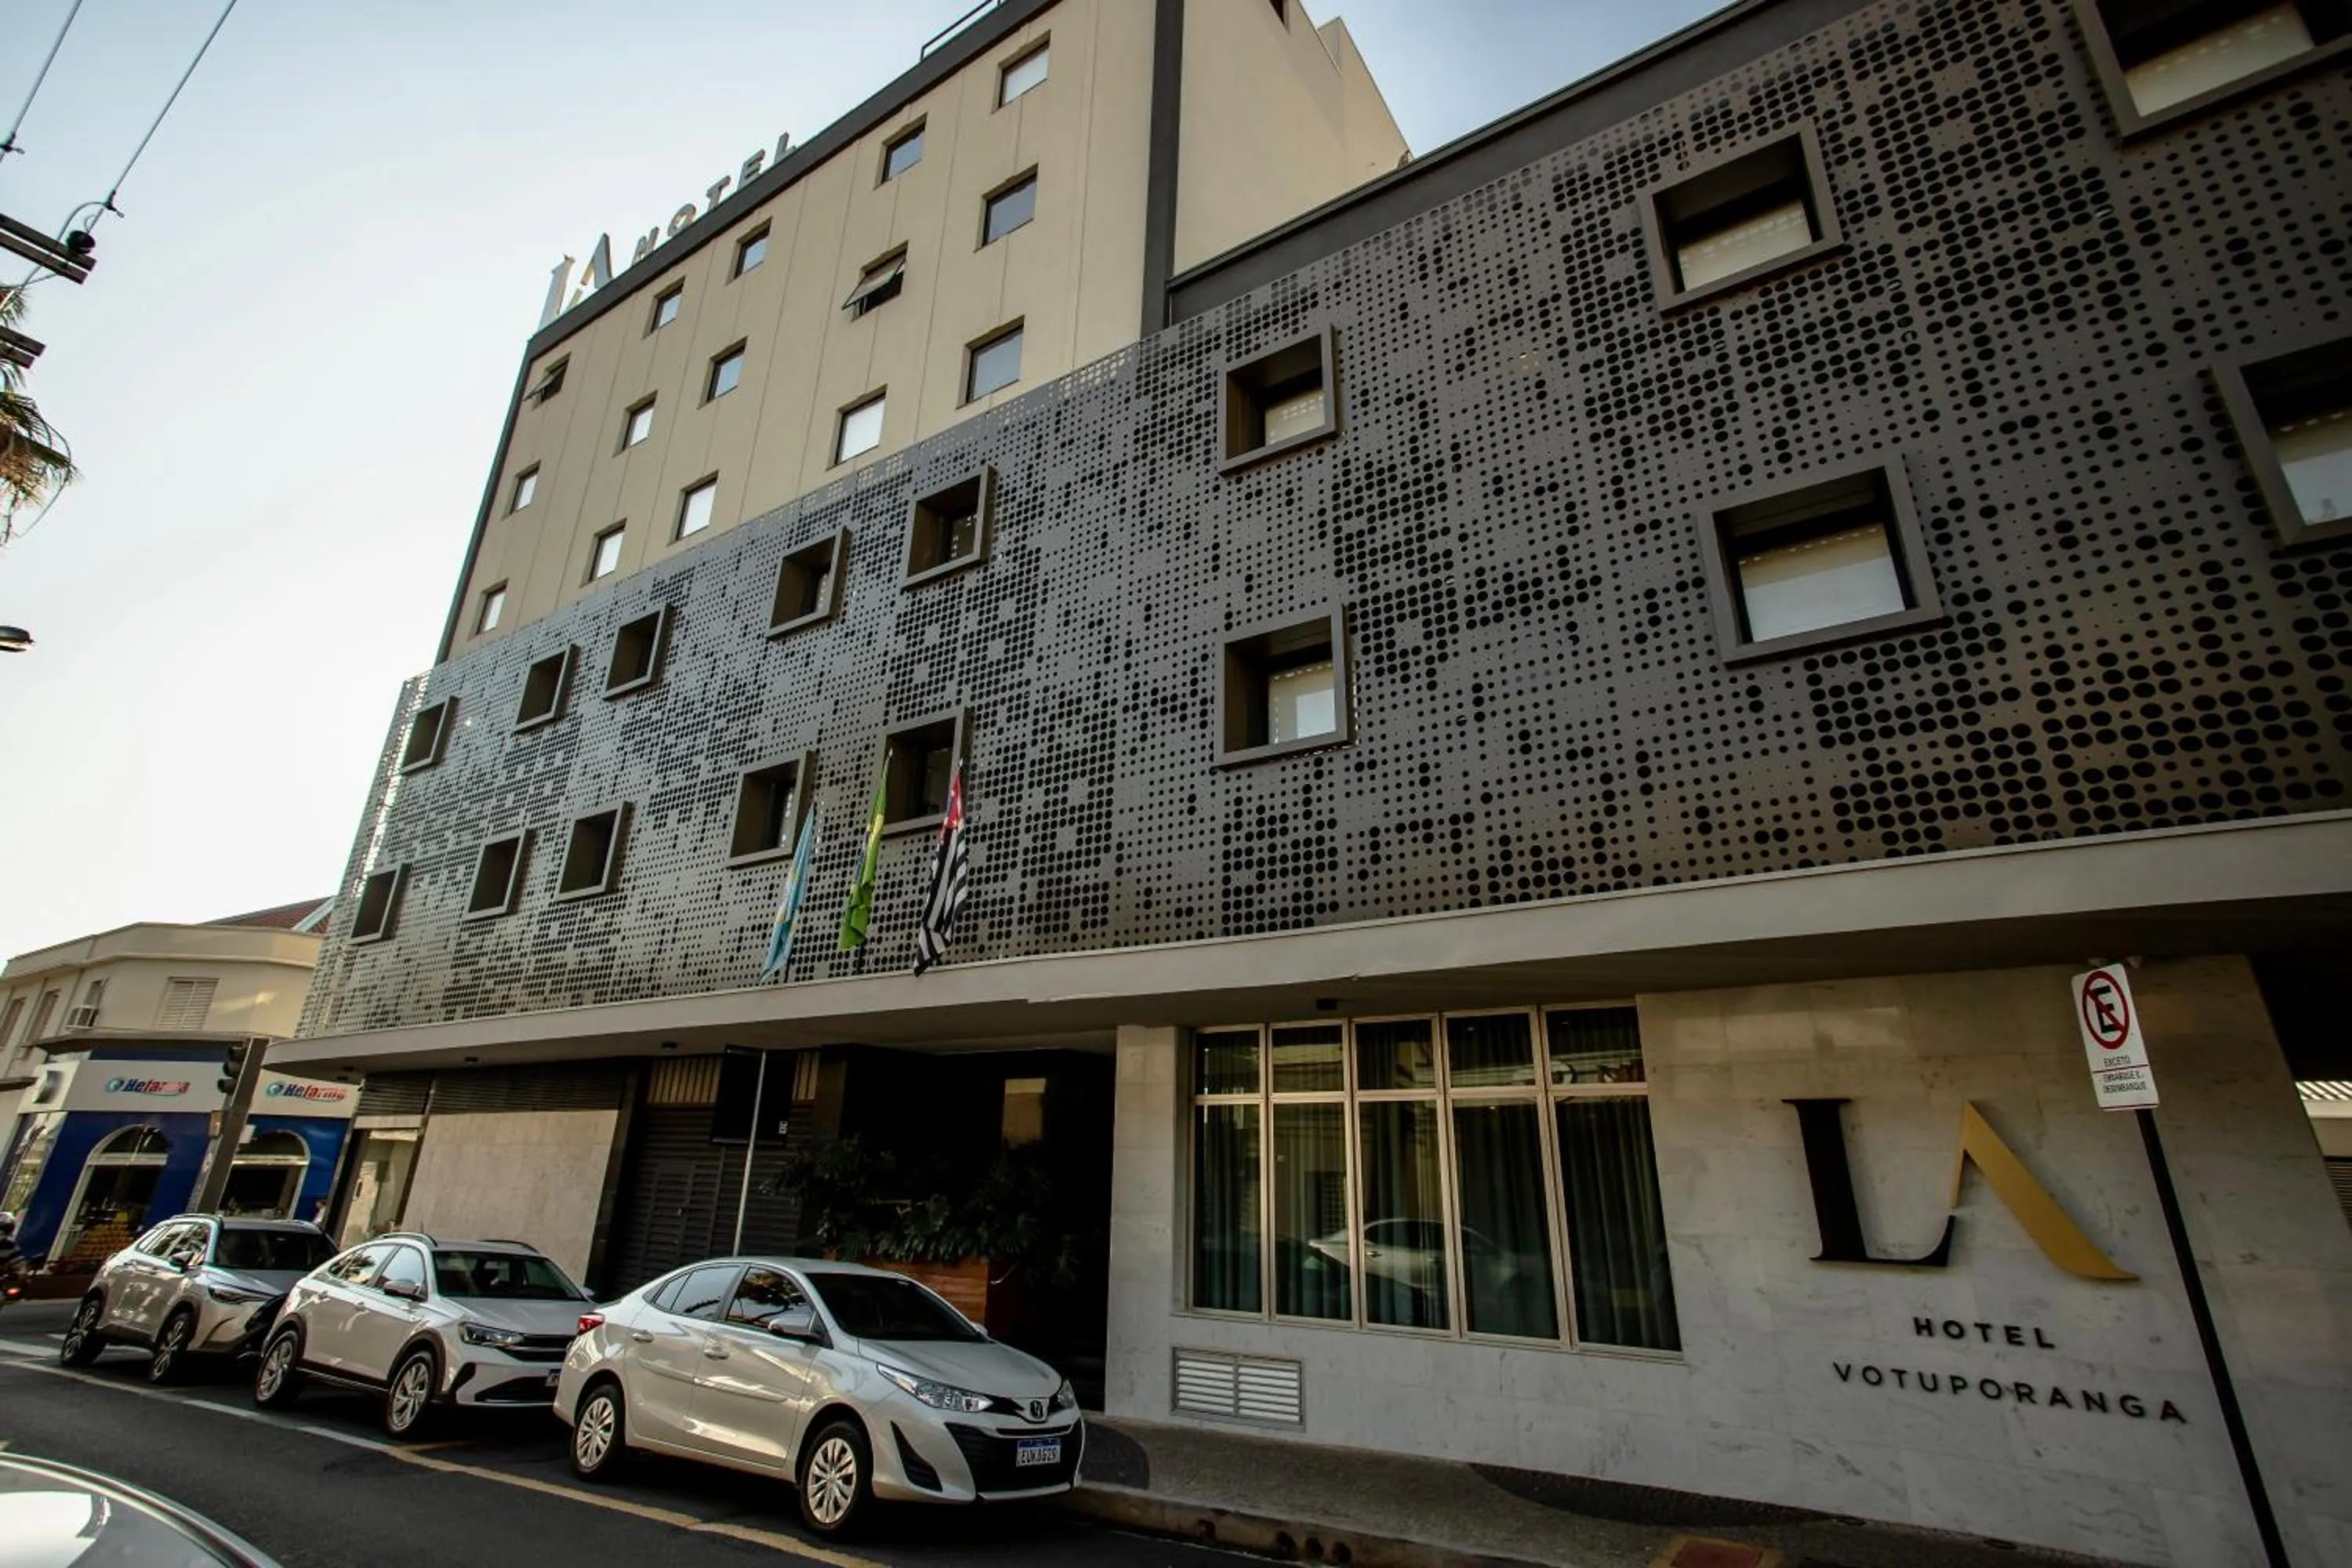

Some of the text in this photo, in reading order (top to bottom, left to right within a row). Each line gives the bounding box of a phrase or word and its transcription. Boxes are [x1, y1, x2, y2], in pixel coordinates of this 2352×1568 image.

[631, 132, 799, 266] HOTEL
[1781, 1098, 2141, 1281] LA
[1913, 1316, 2056, 1349] HOTEL
[1833, 1362, 2187, 1424] VOTUPORANGA
